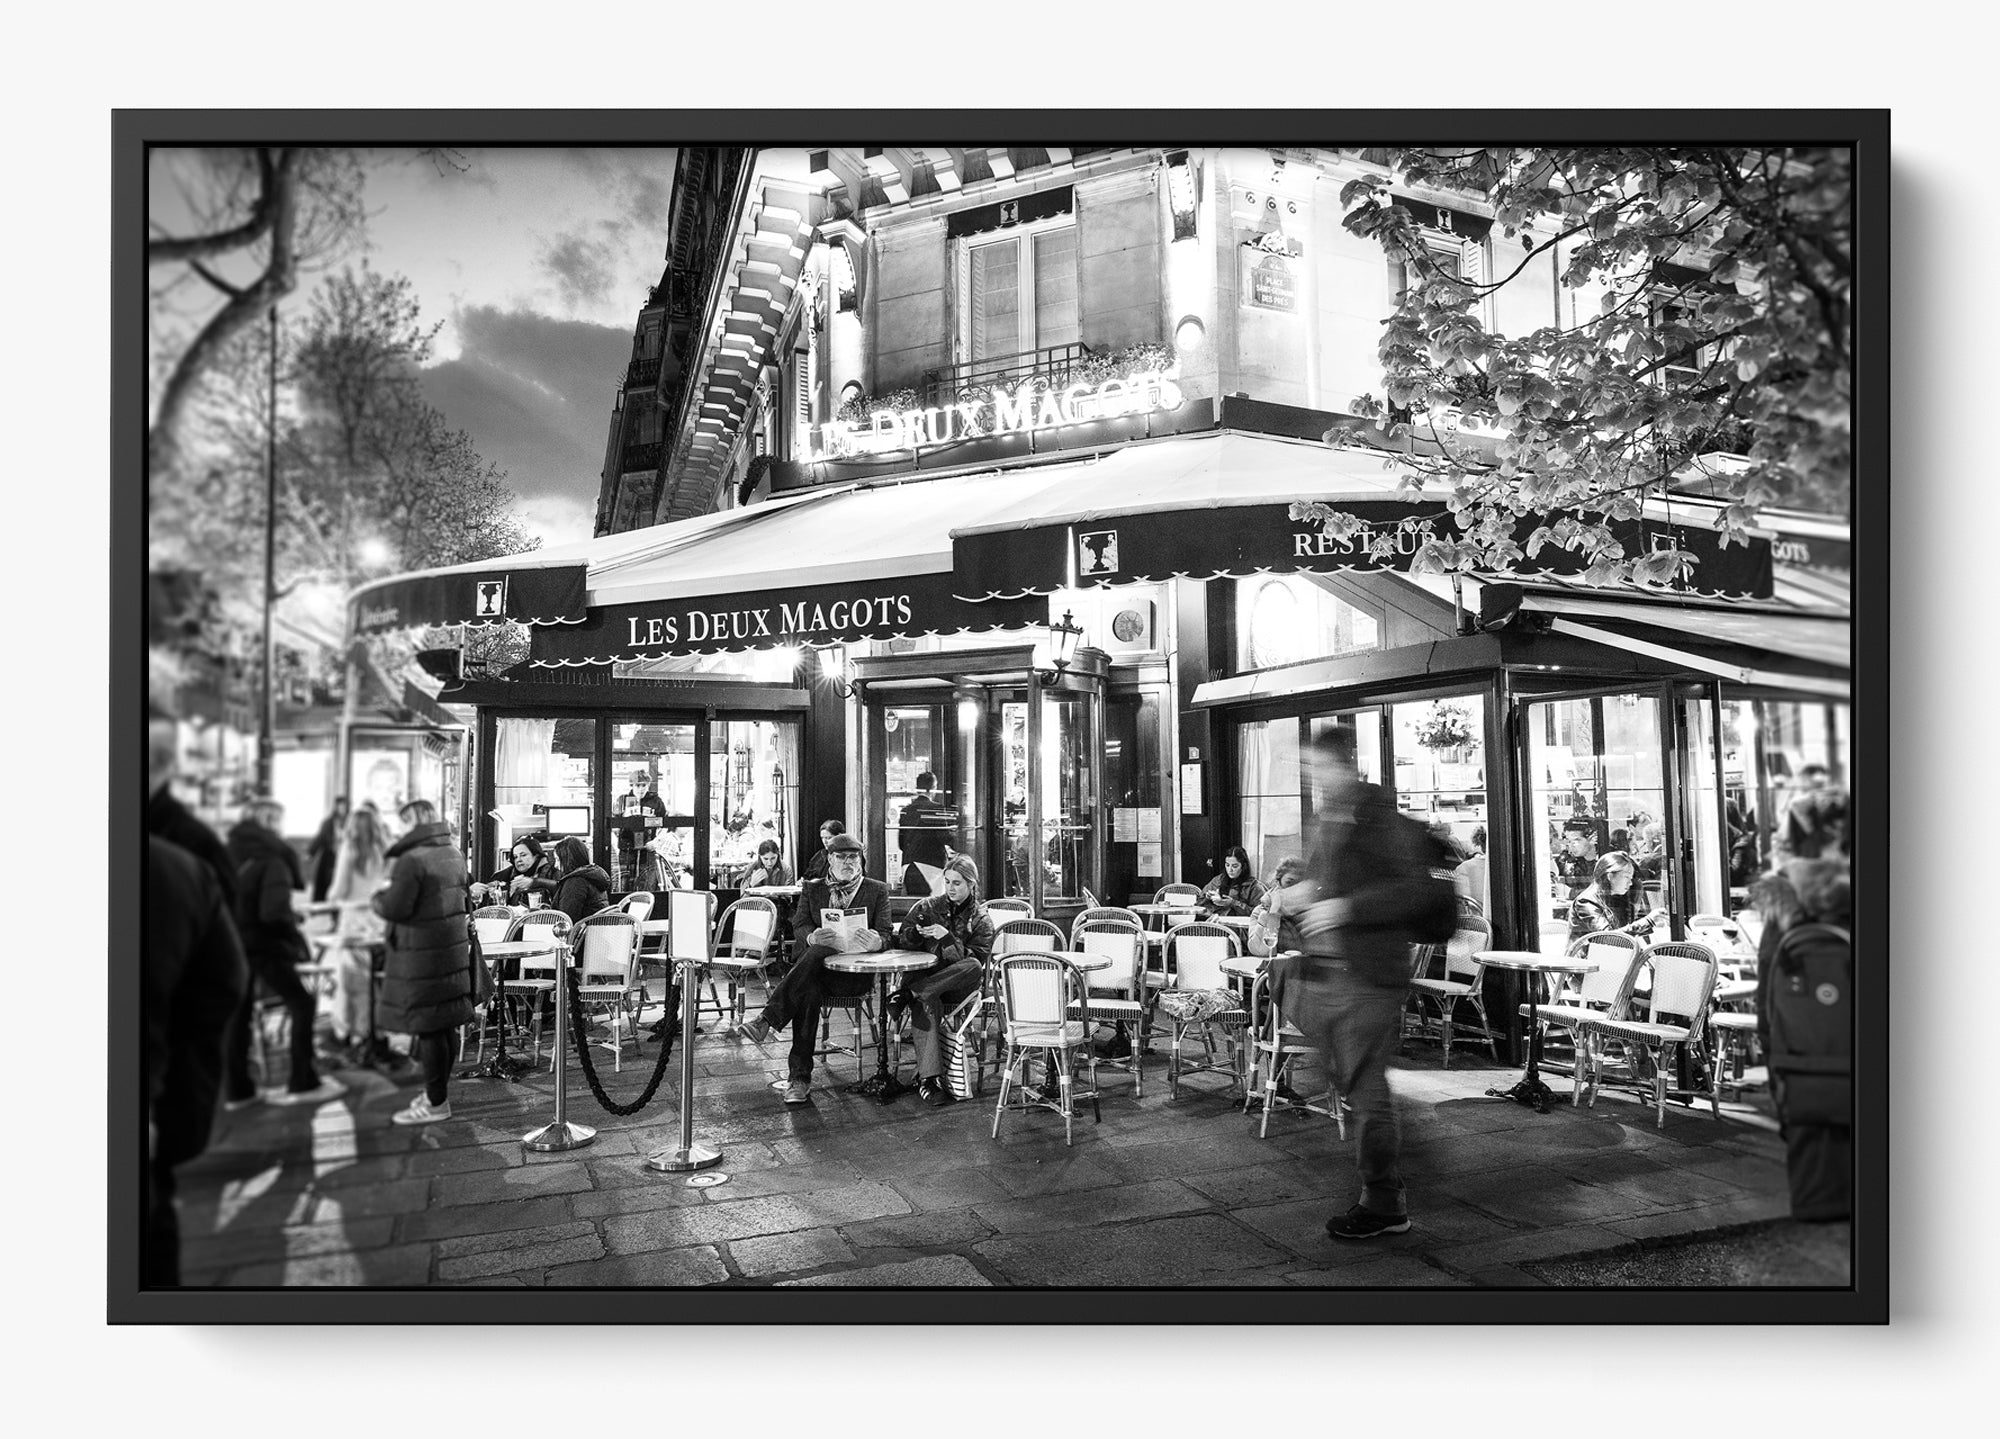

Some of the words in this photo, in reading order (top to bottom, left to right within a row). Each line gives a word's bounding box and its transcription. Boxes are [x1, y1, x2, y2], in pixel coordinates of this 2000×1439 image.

[871, 401, 985, 453] DEUX
[992, 367, 1184, 431] MAGOTS
[1771, 541, 1810, 562] GOTS
[627, 616, 678, 647] LES
[687, 609, 771, 642] DEUX
[779, 594, 912, 635] MAGOTS
